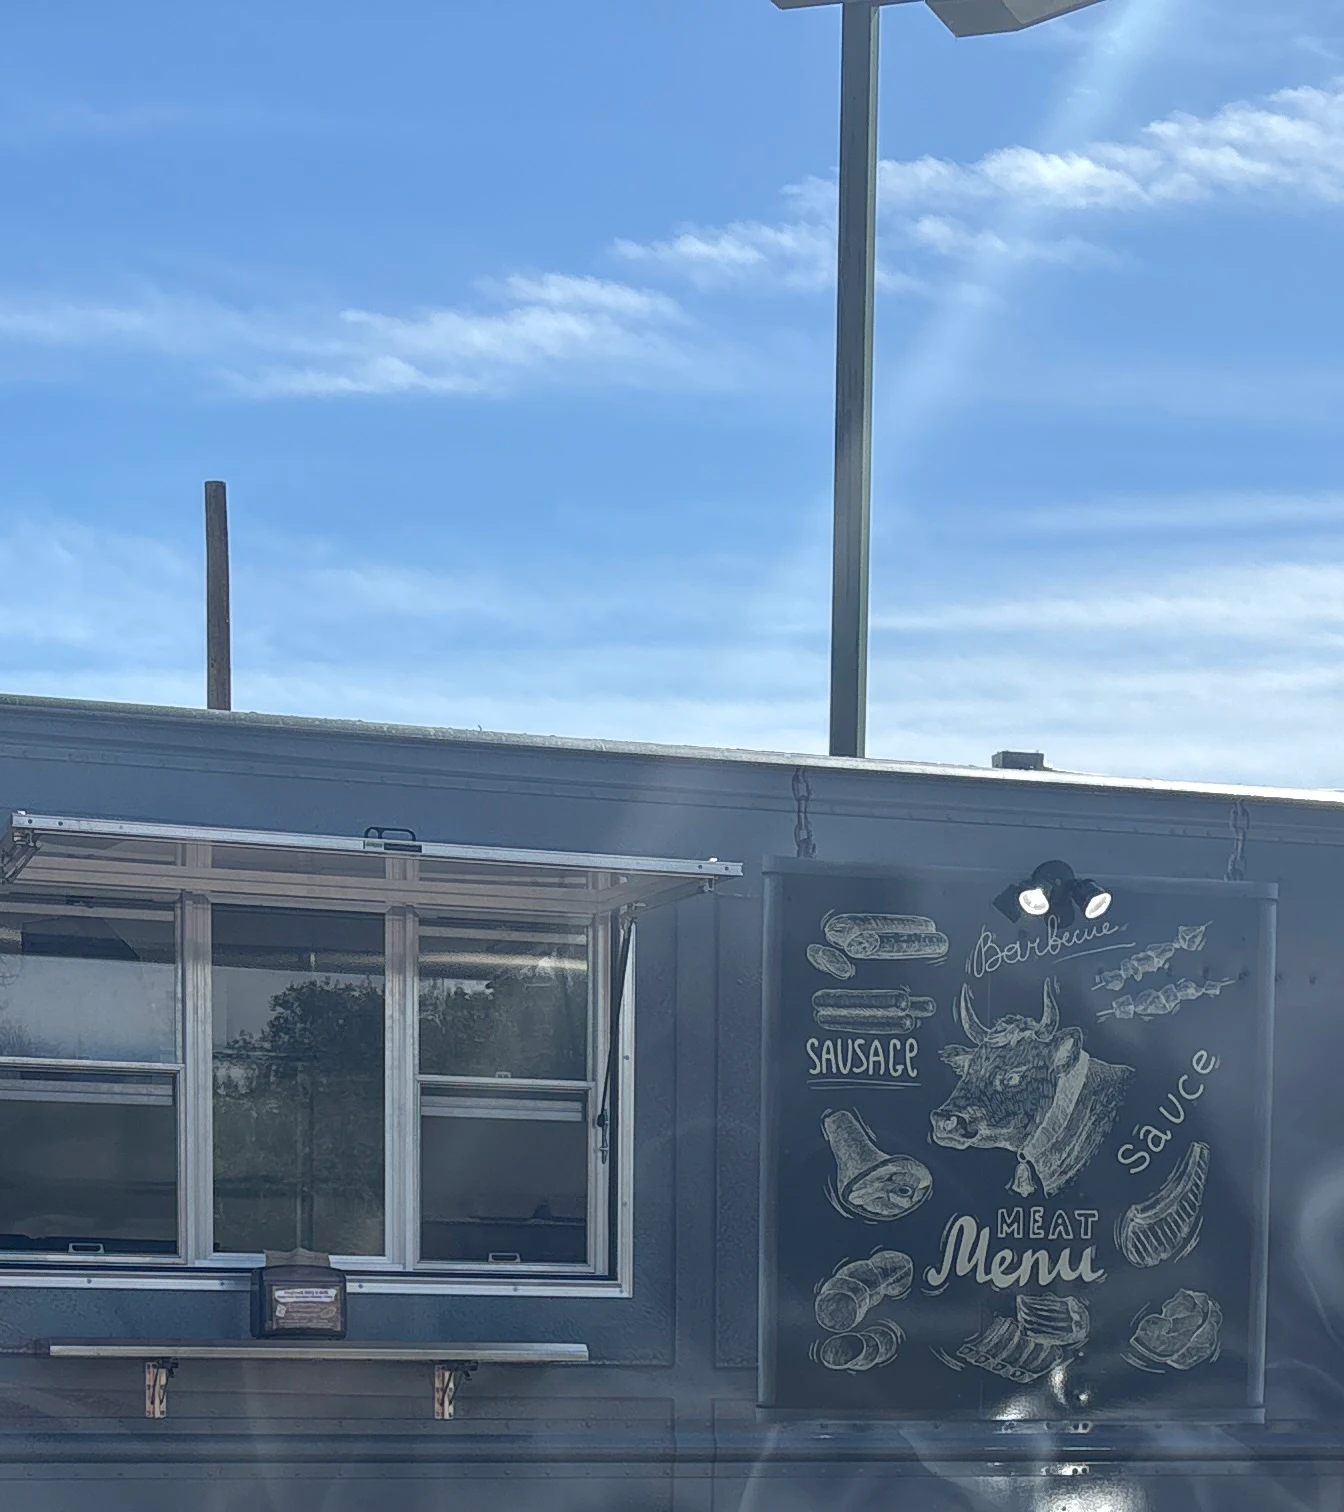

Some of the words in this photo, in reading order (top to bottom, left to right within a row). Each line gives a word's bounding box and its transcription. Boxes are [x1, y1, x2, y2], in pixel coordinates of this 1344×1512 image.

[973, 914, 1120, 978] Barbecue
[927, 1214, 1106, 1289] Menu
[997, 1207, 1100, 1240] MEAT
